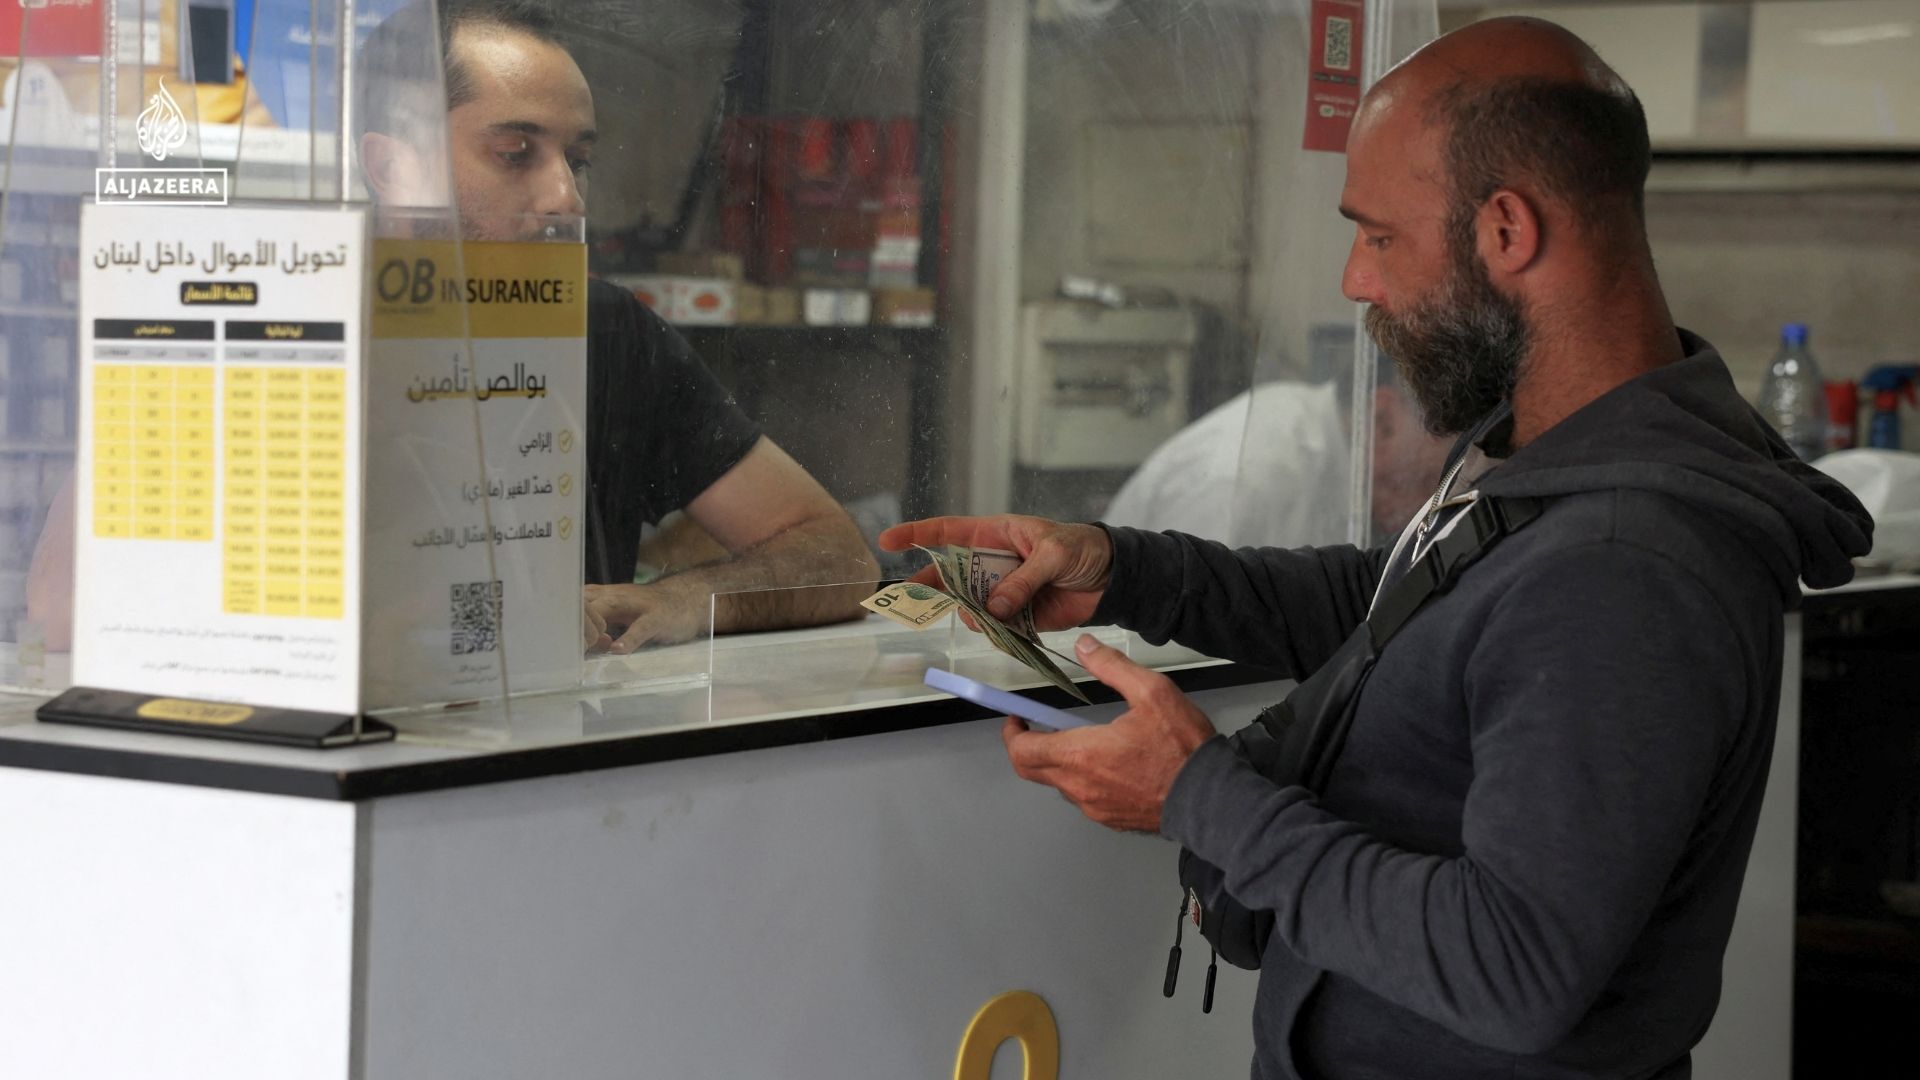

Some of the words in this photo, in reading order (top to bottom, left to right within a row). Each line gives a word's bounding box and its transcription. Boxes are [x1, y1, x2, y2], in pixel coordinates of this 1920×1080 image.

[94, 241, 140, 273] لبنان
[146, 241, 195, 274] داخل
[202, 239, 276, 274] الأموال
[281, 244, 347, 275] تحويل
[377, 258, 436, 304] OB
[441, 279, 563, 304] INSURANCE
[408, 353, 470, 402] تأمين
[474, 362, 546, 402] بوالص
[519, 431, 552, 456] إلزامي
[874, 593, 900, 608] 10
